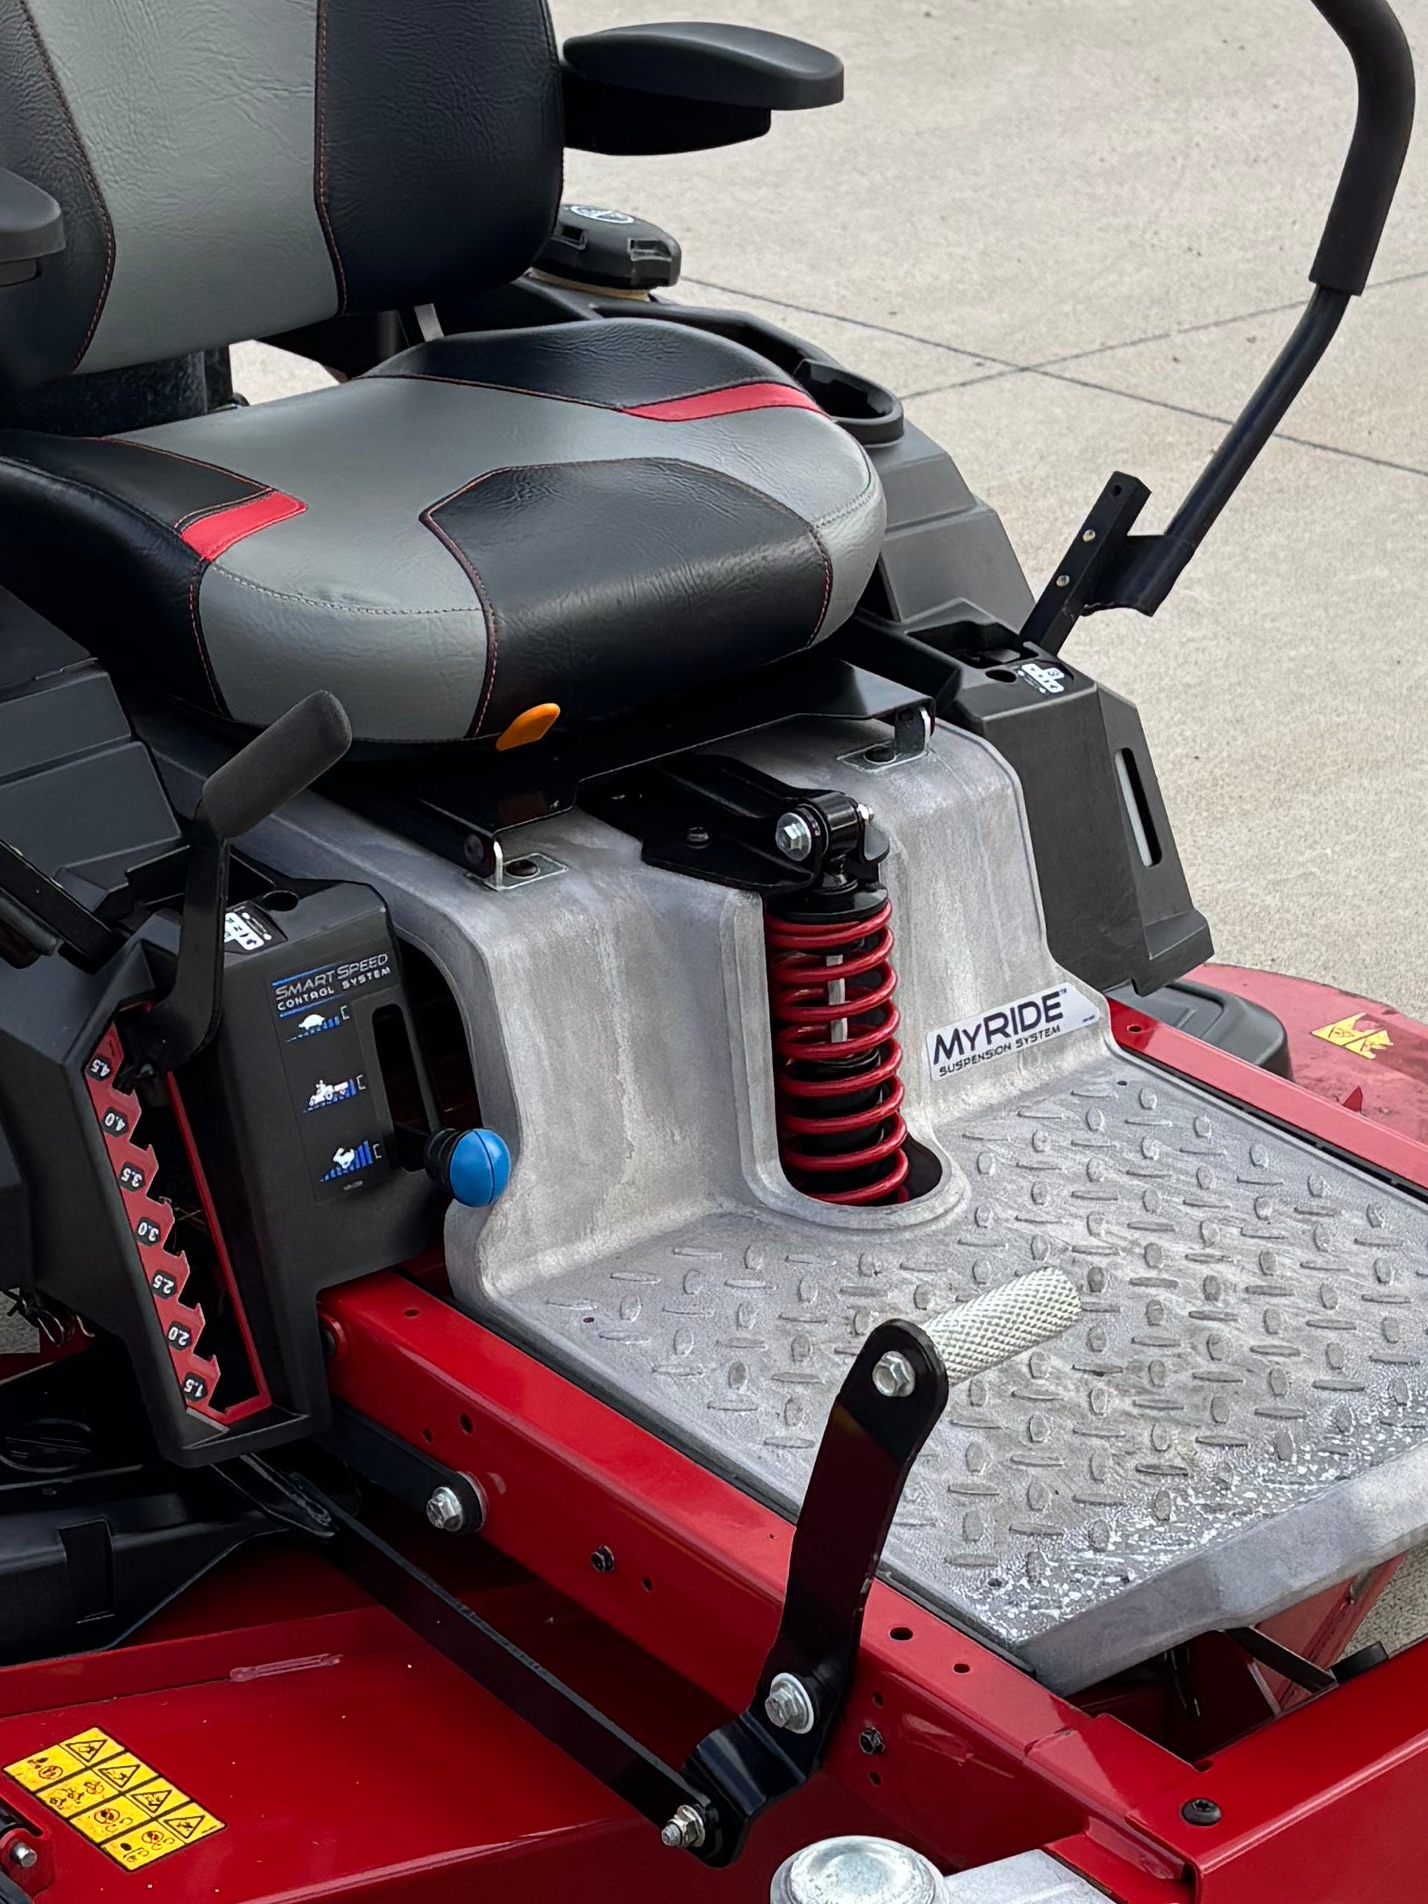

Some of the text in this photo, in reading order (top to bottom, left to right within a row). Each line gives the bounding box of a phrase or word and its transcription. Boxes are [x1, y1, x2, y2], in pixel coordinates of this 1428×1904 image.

[277, 966, 391, 1011] CONTROL SYSTEM
[939, 1025, 1062, 1077] SUSPENSION SYSTEM
[90, 1058, 111, 1078] 4.5
[104, 1111, 127, 1132] 4.0
[120, 1166, 143, 1188] 3.5
[136, 1221, 160, 1242] 3.0
[152, 1273, 175, 1295] 2.5
[167, 1325, 190, 1347] 2.0
[183, 1378, 205, 1398] 1.5
